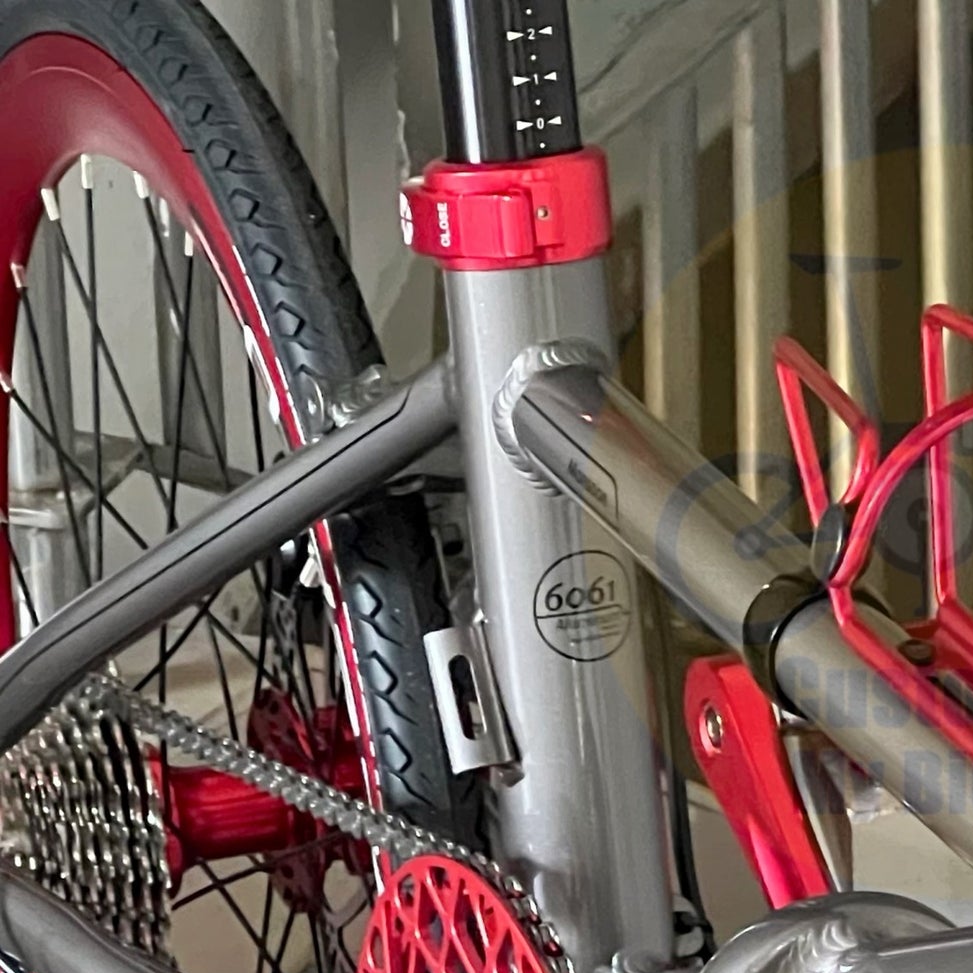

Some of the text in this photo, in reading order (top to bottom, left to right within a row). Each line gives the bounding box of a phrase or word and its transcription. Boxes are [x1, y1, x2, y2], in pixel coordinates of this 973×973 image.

[527, 28, 536, 40] 2
[533, 73, 539, 85] 1
[536, 117, 545, 130] 0
[437, 202, 451, 248] CLOSE
[545, 576, 615, 612] 6061
